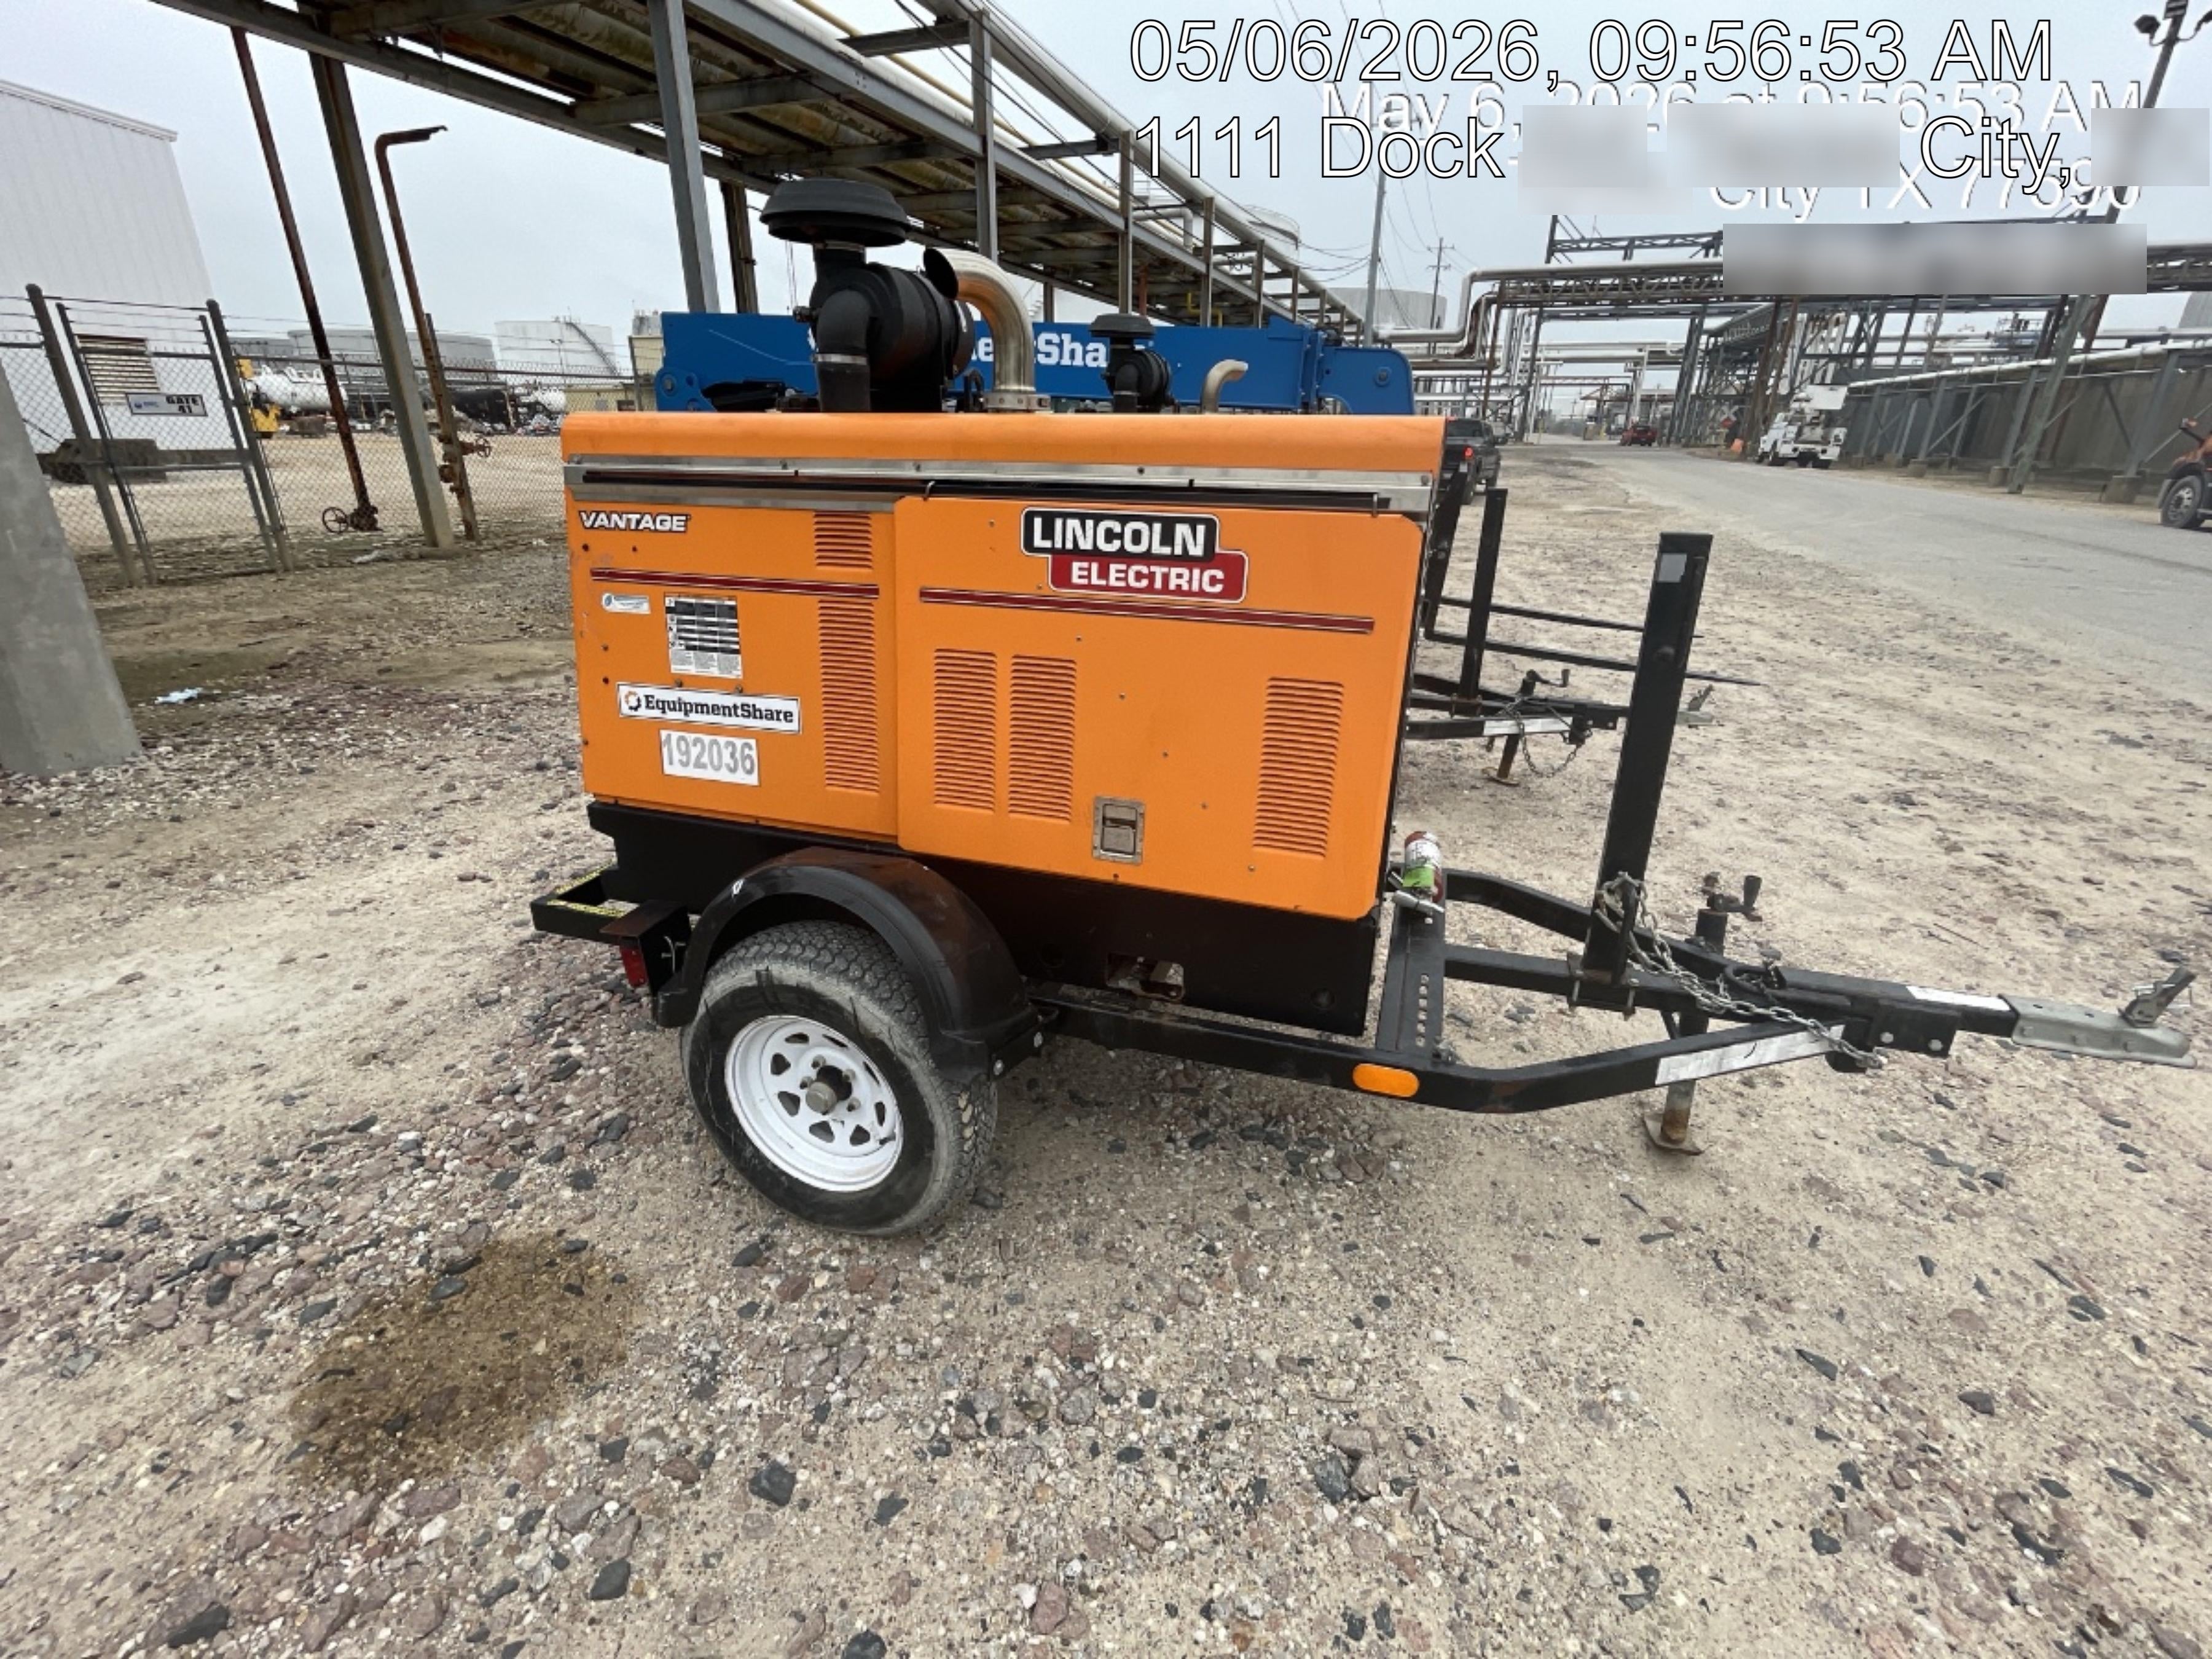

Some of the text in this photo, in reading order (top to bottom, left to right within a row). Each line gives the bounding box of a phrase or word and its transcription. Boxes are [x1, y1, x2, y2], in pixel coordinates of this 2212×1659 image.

[580, 511, 688, 532] VANTAGE
[1033, 516, 1206, 557] LINCOLN
[1070, 561, 1225, 593] ELECTRIC
[644, 694, 794, 723] EquipmentShare
[663, 733, 755, 775] 192036
